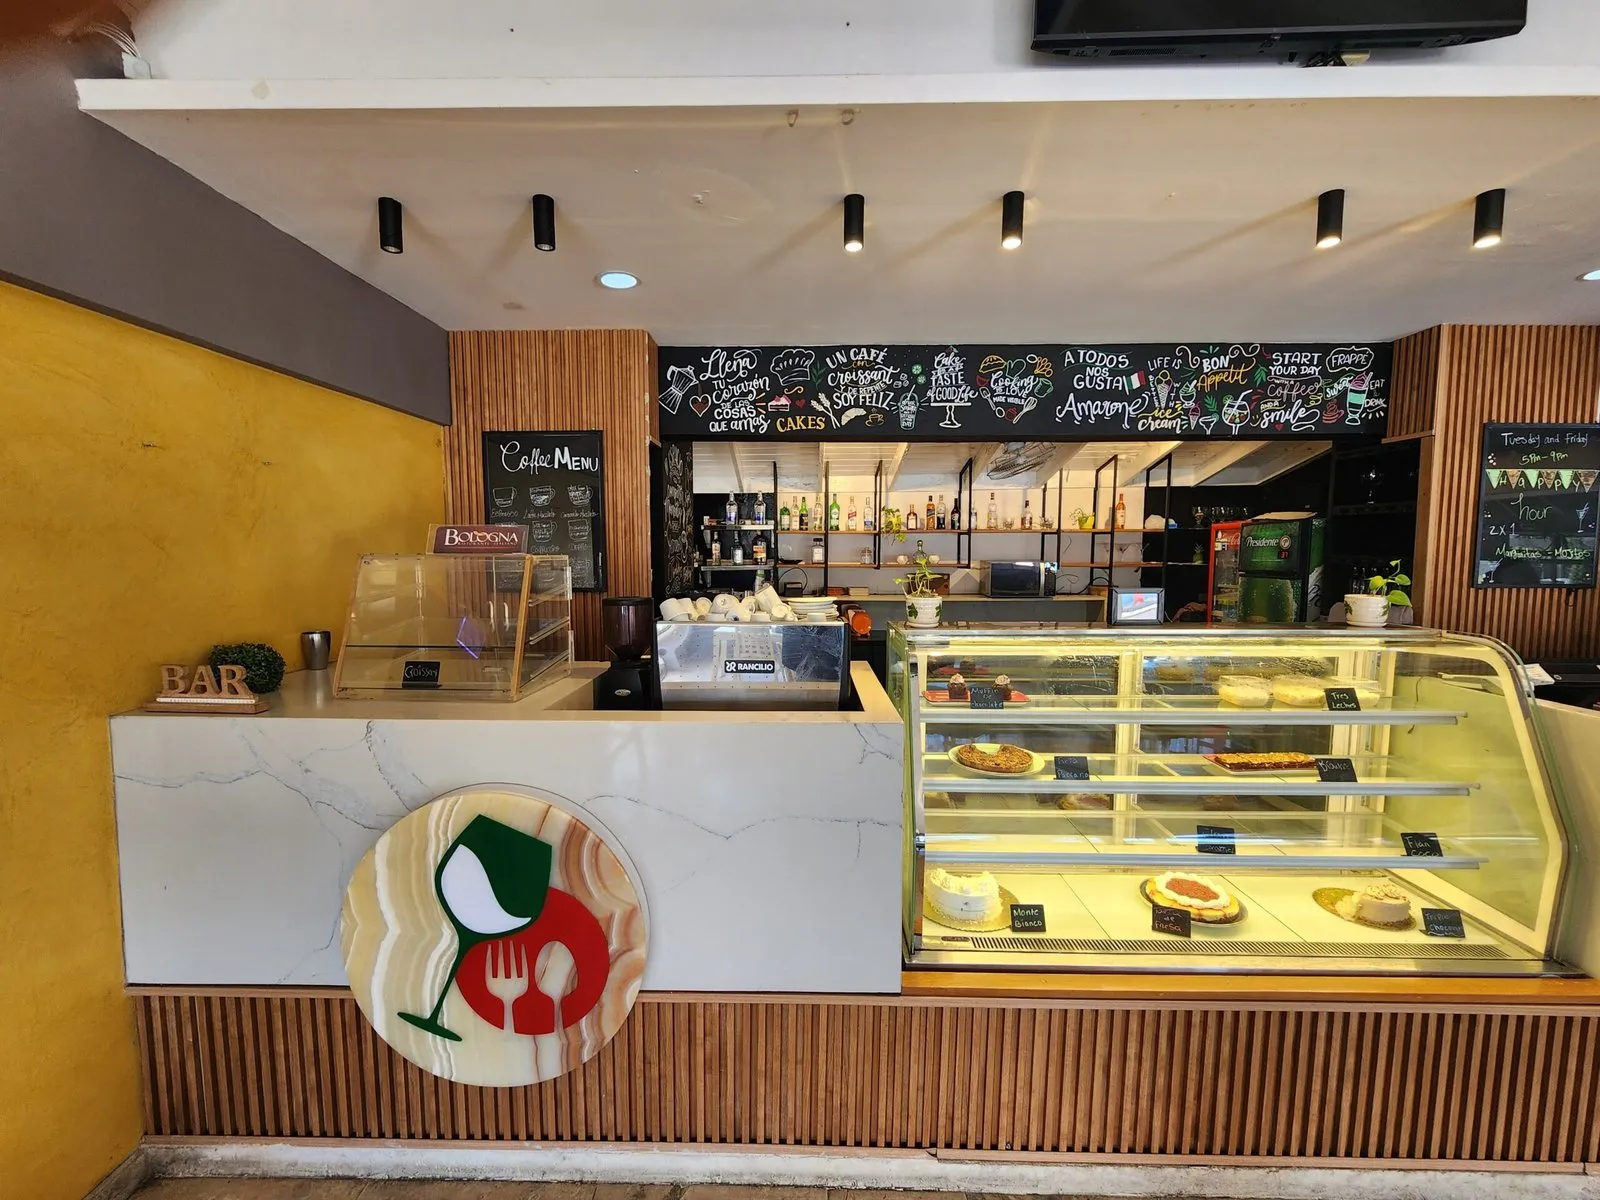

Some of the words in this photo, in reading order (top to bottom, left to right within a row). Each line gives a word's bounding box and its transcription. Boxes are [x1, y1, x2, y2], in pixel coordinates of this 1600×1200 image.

[700, 349, 760, 382] Llena
[825, 350, 848, 369] UN
[849, 347, 888, 364] CAFÉ
[934, 352, 966, 369] Cake
[1064, 351, 1075, 367] A
[1077, 350, 1130, 368] TODOS
[1147, 356, 1171, 371] LIFE
[1171, 359, 1183, 370] IS
[1202, 355, 1230, 373] BON
[1272, 352, 1322, 365] START
[931, 371, 965, 386] TASTE
[1086, 367, 1109, 376] NOS
[1269, 366, 1298, 376] YOUR
[1300, 366, 1322, 376] DAY
[712, 379, 725, 390] TU
[990, 370, 1039, 393] Cooking
[1073, 374, 1123, 390] GUSTA
[848, 386, 858, 395] DE
[936, 386, 958, 401] GOOD
[1005, 386, 1028, 399] LOVE
[720, 402, 732, 410] DE
[734, 400, 750, 408] LAS
[833, 392, 857, 409] SOY
[859, 391, 895, 411] FELIZ
[713, 405, 757, 419] COSAS
[1056, 392, 1150, 430] Amarone
[709, 421, 729, 432] QUE
[730, 414, 771, 434] amas
[776, 415, 826, 433] CAKES
[1500, 432, 1541, 448] Tuesday
[1544, 434, 1560, 445] and
[500, 441, 553, 475] Coffee
[1245, 536, 1280, 547] Presidente
[737, 663, 773, 671] RANCILIO
[160, 664, 255, 698] BAR
[1331, 692, 1349, 700] Tres
[1404, 835, 1432, 849] Flan
[1013, 908, 1040, 917] Monte
[1014, 919, 1043, 928] Bianco
